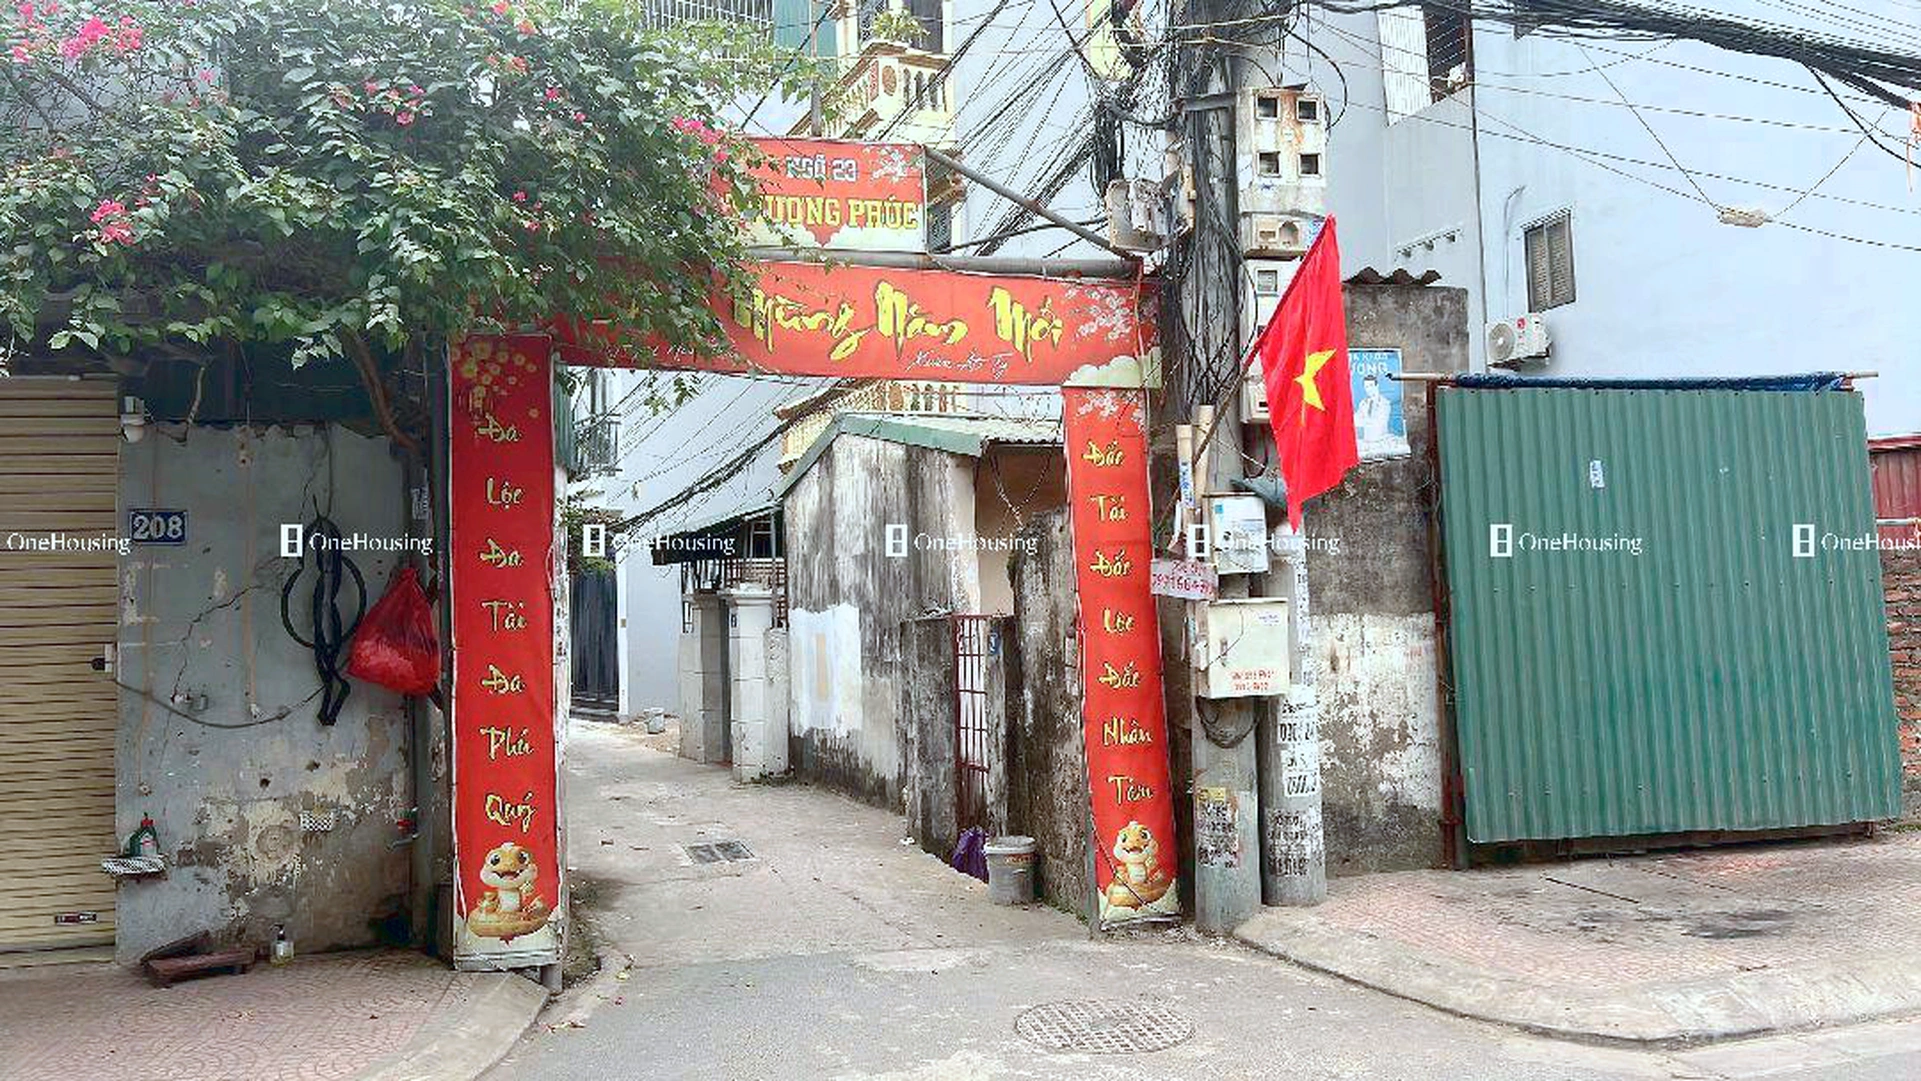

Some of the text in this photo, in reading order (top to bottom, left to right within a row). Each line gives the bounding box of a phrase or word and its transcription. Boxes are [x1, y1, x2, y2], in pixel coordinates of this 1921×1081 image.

[832, 159, 858, 182] 23
[848, 196, 918, 229] PHÚC
[875, 280, 968, 360] Năm
[986, 286, 1064, 363] Mới
[487, 477, 525, 510] Lộc
[1090, 495, 1127, 521] Tài
[133, 515, 185, 539] 208
[480, 538, 524, 568] Đa
[481, 600, 527, 633] Tài
[482, 664, 525, 694] Đa
[479, 727, 534, 760] Phú
[1103, 717, 1153, 746] Nhân
[486, 792, 534, 832] Quý
